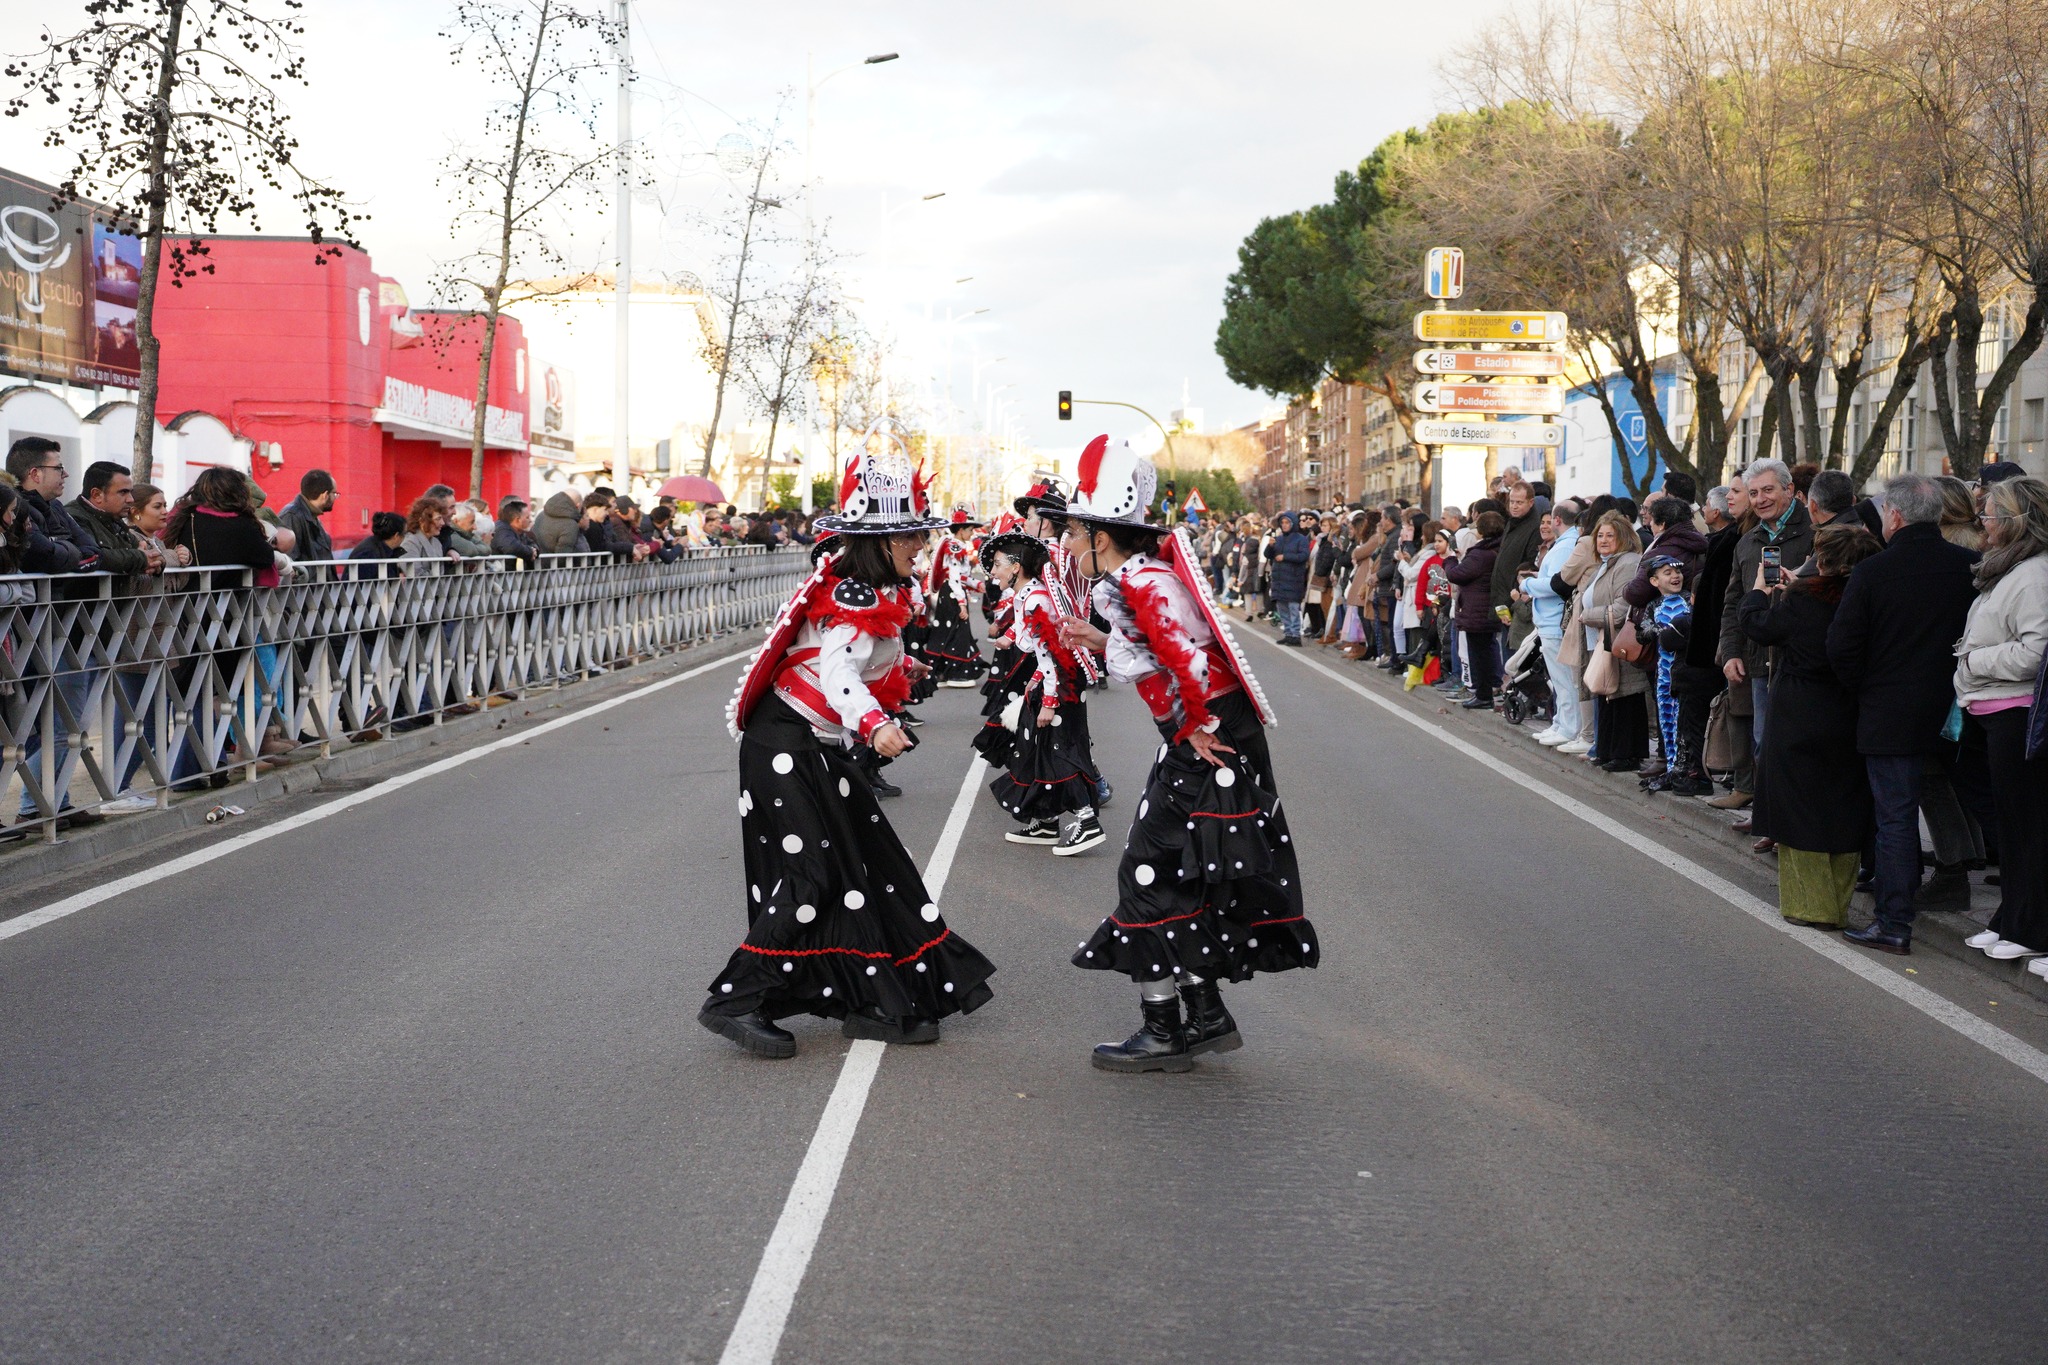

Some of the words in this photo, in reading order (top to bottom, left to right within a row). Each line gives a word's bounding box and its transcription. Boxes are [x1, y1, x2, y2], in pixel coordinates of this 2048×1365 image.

[42, 280, 84, 307] CECILIO
[1458, 316, 1467, 326] de
[1457, 327, 1467, 337] de
[1475, 357, 1510, 368] Estadio
[1512, 358, 1558, 370] Municipal
[1483, 388, 1514, 398] Piscina
[1516, 389, 1554, 400] Municip
[1458, 397, 1514, 408] Polideportivo
[1425, 426, 1449, 438] Centro
[1450, 427, 1460, 438] de
